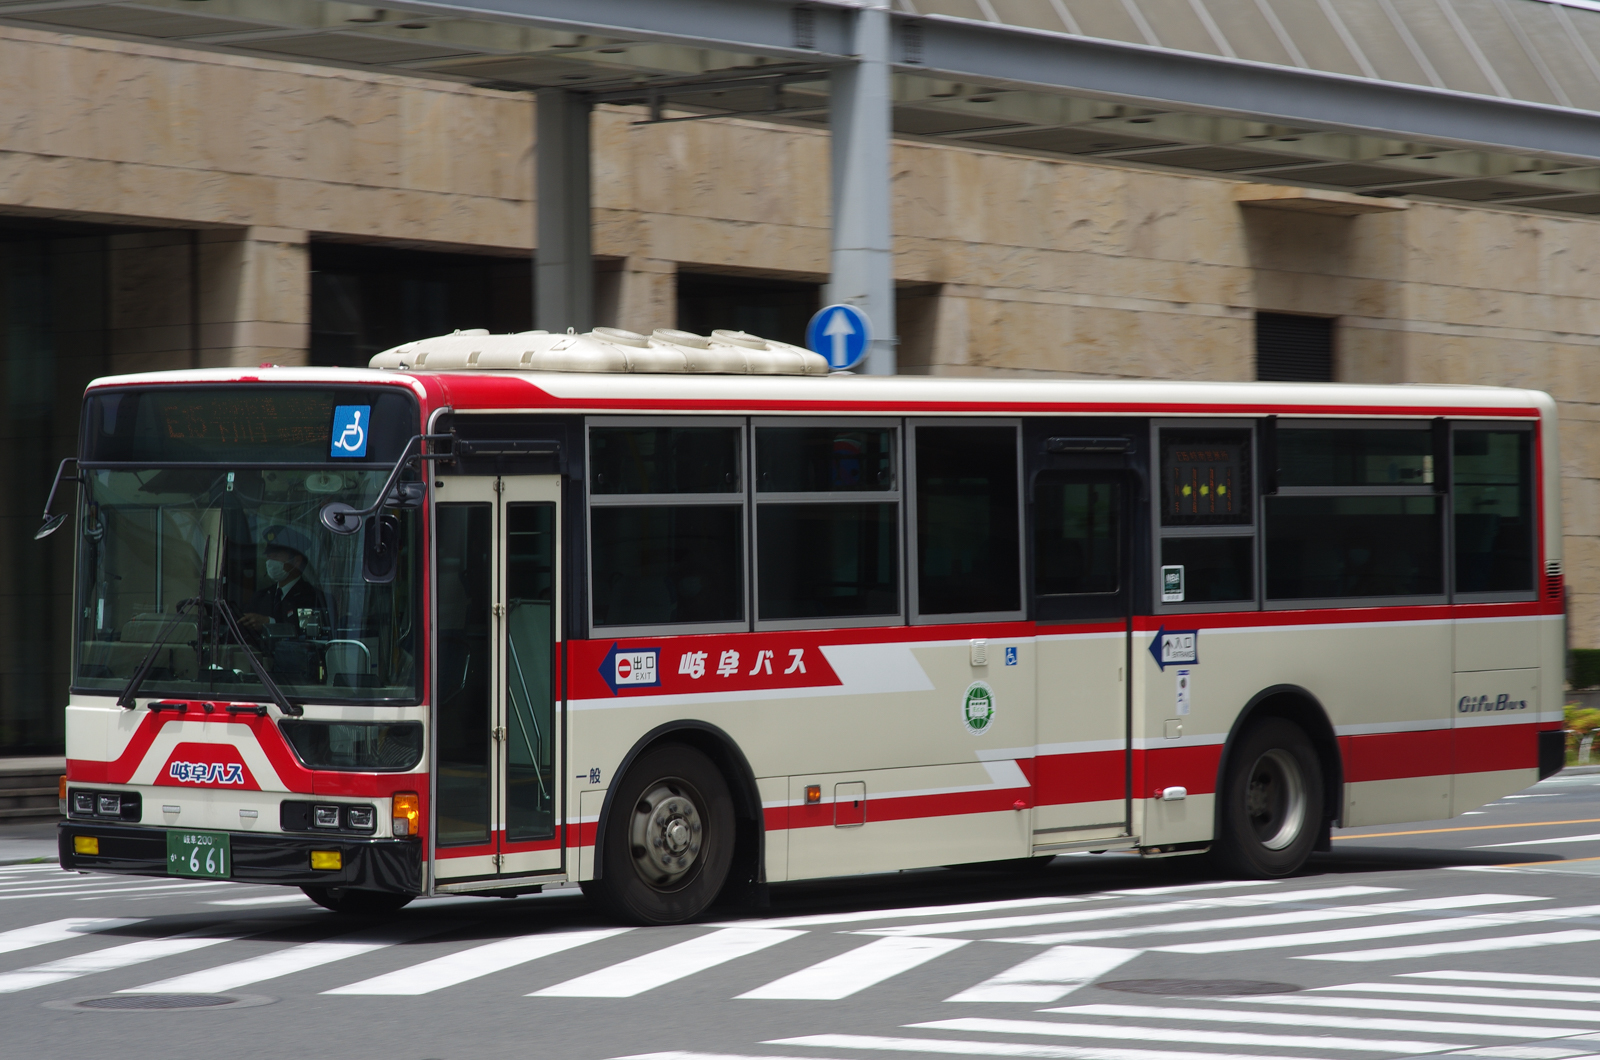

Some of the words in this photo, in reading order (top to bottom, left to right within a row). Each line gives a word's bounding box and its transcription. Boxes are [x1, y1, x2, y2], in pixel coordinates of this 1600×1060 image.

[1174, 636, 1192, 649] 入口
[633, 655, 654, 670] 出口
[678, 649, 807, 679] 岐阜バス
[635, 671, 652, 681] EXIT
[169, 761, 244, 784] 岐阜バス
[576, 767, 601, 784] 一般
